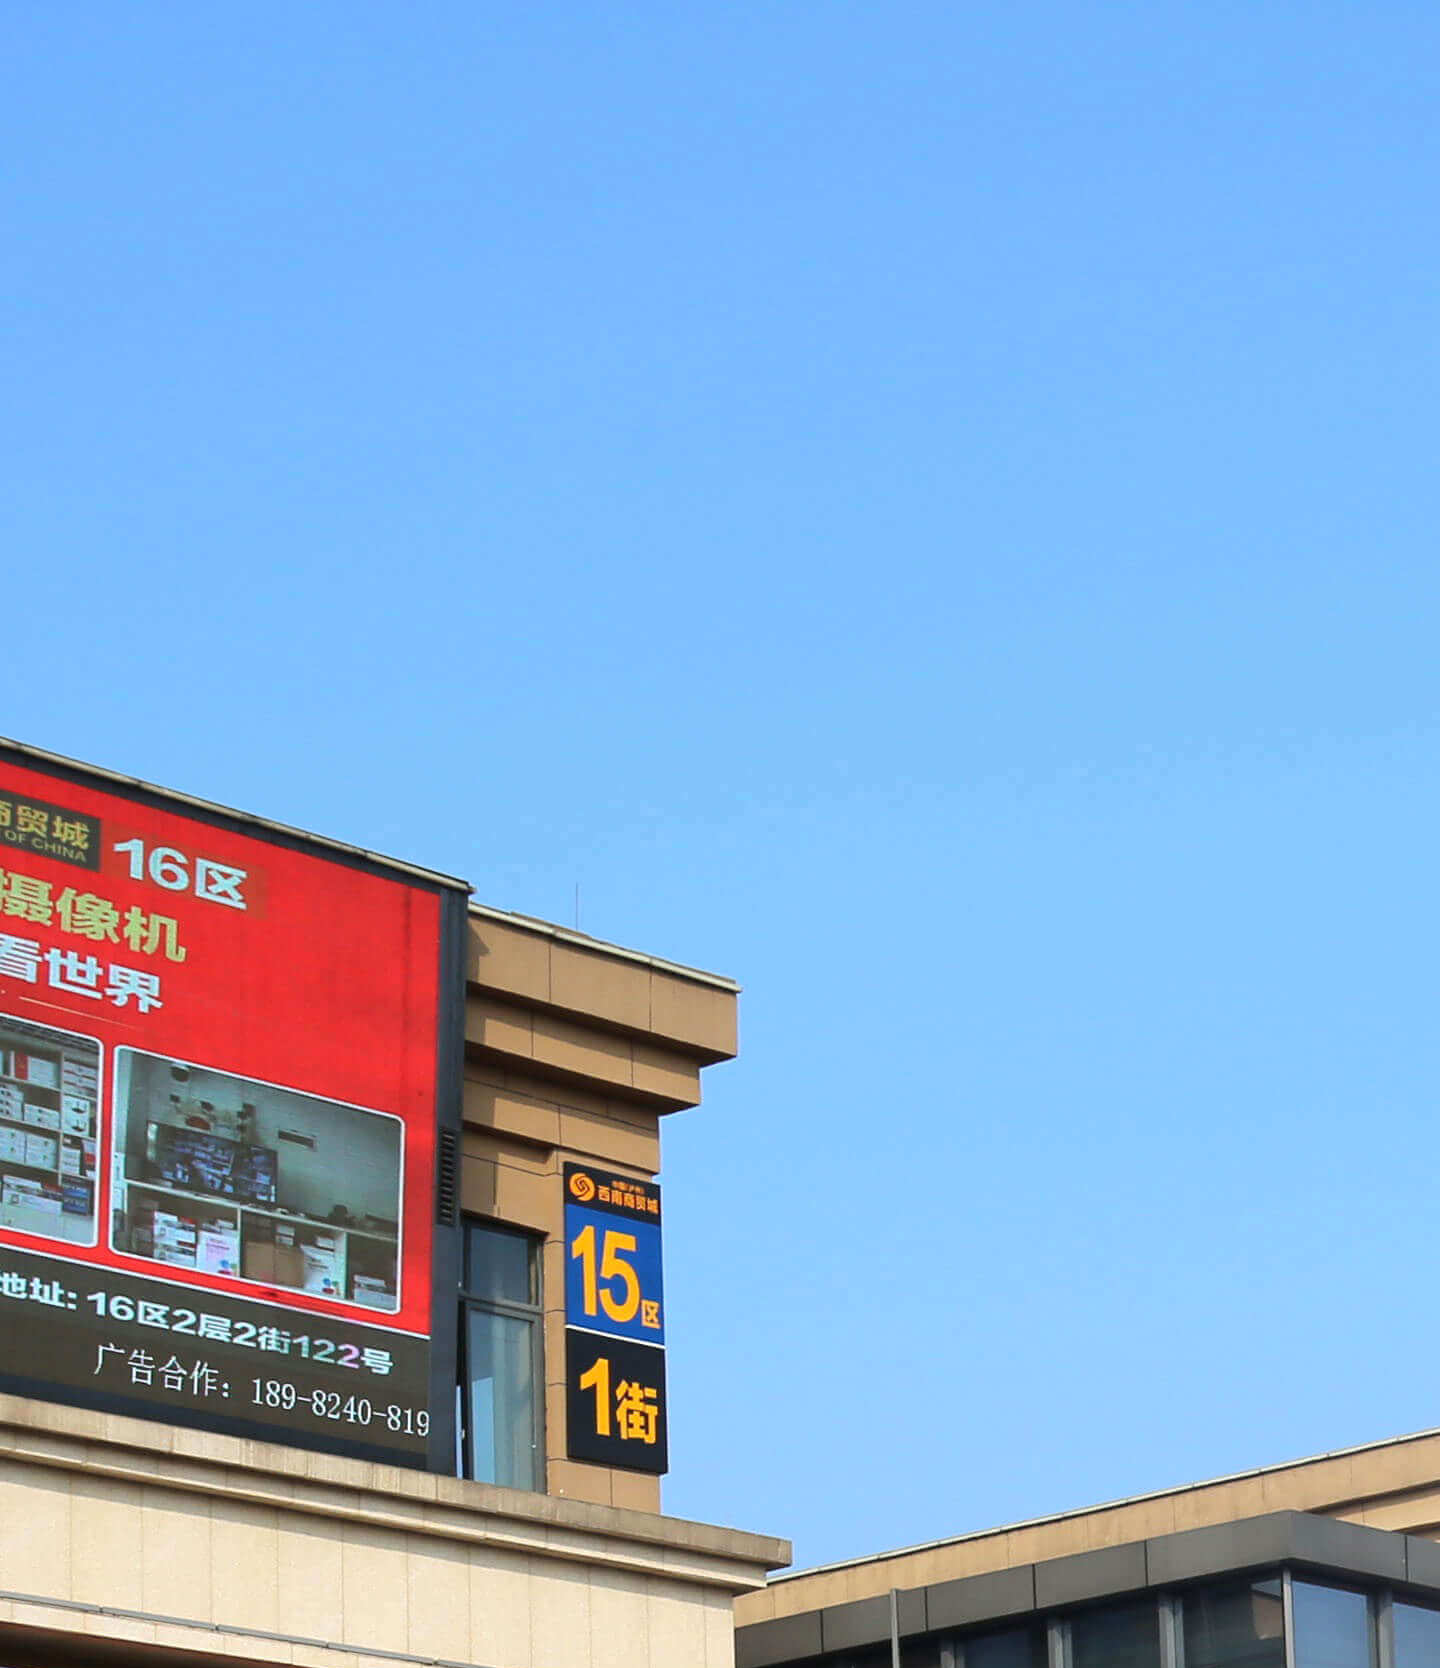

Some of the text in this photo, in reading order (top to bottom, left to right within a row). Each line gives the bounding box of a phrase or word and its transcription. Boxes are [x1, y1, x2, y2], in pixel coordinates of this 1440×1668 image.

[5, 828, 27, 844] OF
[32, 837, 87, 863] CHINA
[114, 837, 248, 910] 16区
[572, 1225, 660, 1329] 15区
[580, 1357, 658, 1444] 1街
